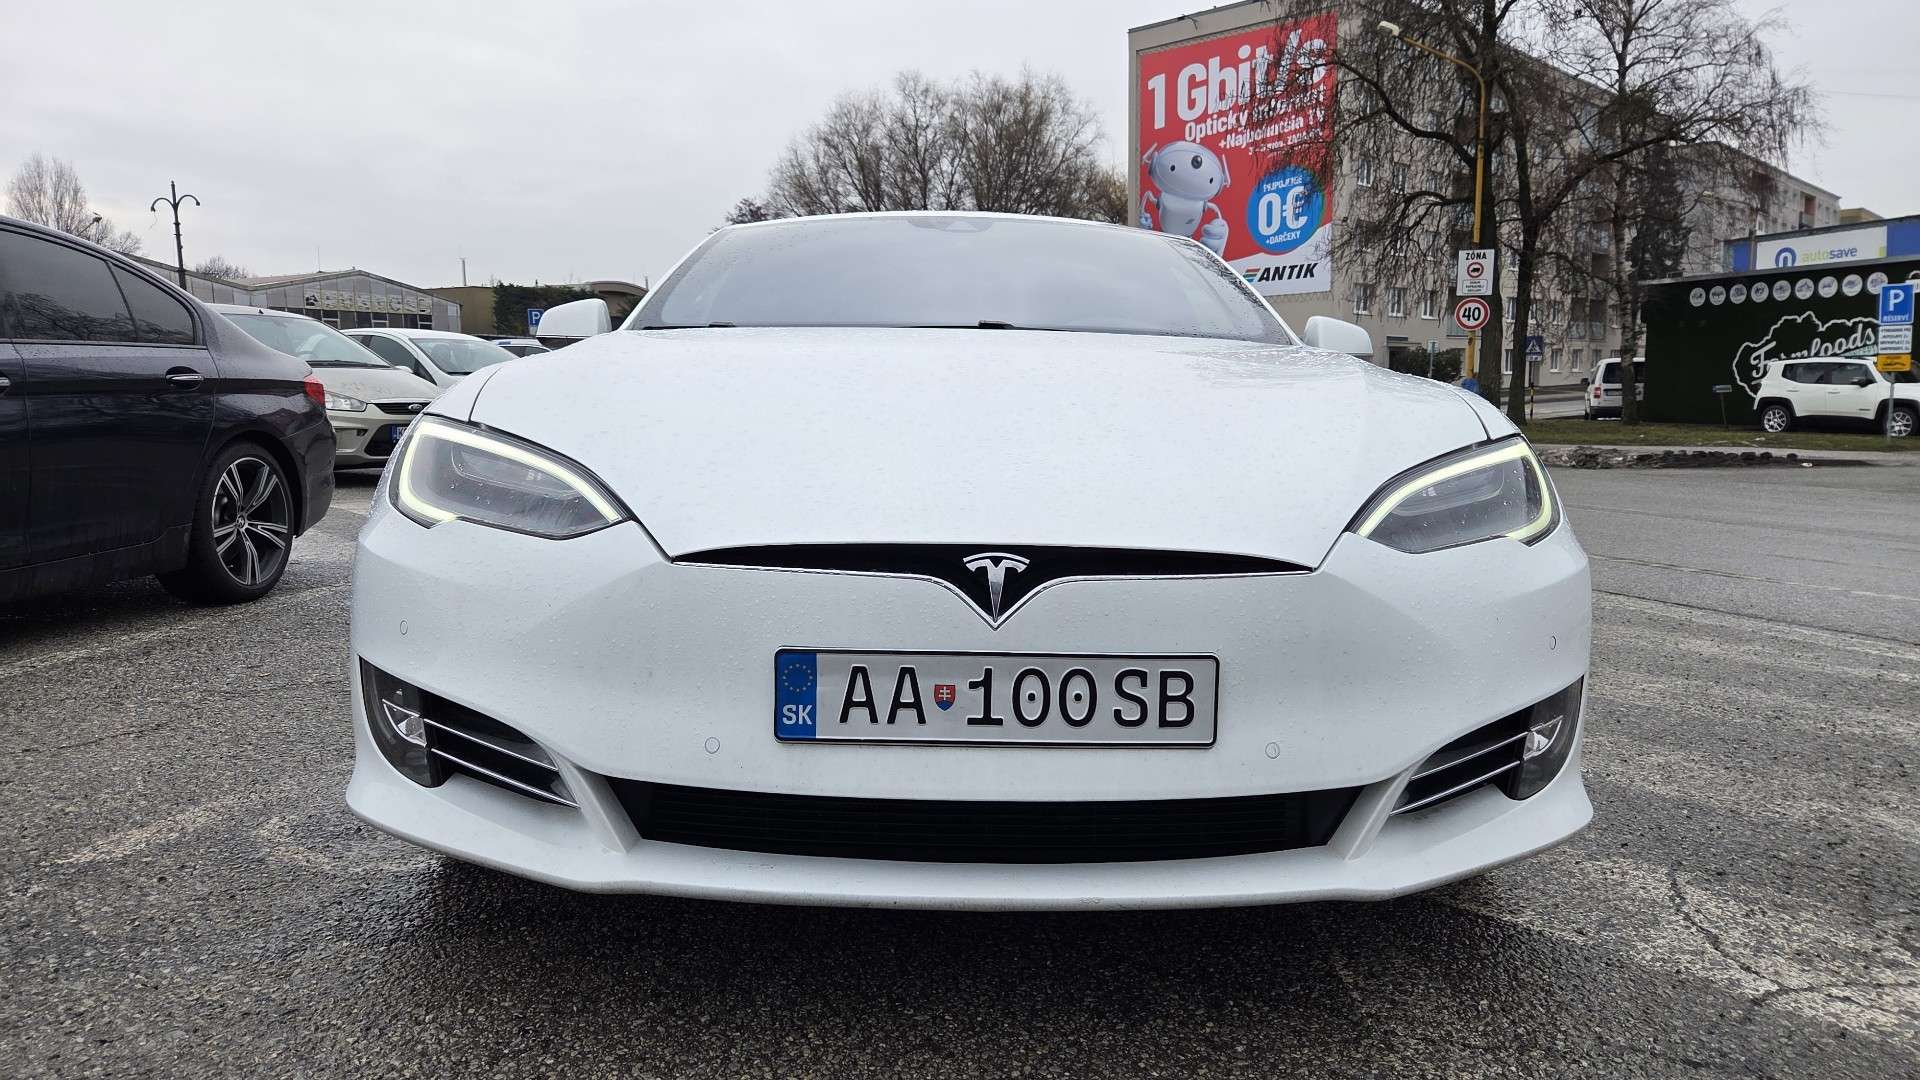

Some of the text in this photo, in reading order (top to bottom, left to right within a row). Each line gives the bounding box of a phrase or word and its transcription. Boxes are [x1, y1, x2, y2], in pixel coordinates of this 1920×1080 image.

[1147, 73, 1166, 130] 1
[1258, 185, 1308, 236] 0€
[1801, 246, 1858, 263] autosave
[1258, 262, 1318, 283] ANTIK
[1889, 289, 1905, 312] P
[1461, 306, 1482, 322] 40
[839, 665, 927, 724] AA
[782, 704, 813, 726] SK
